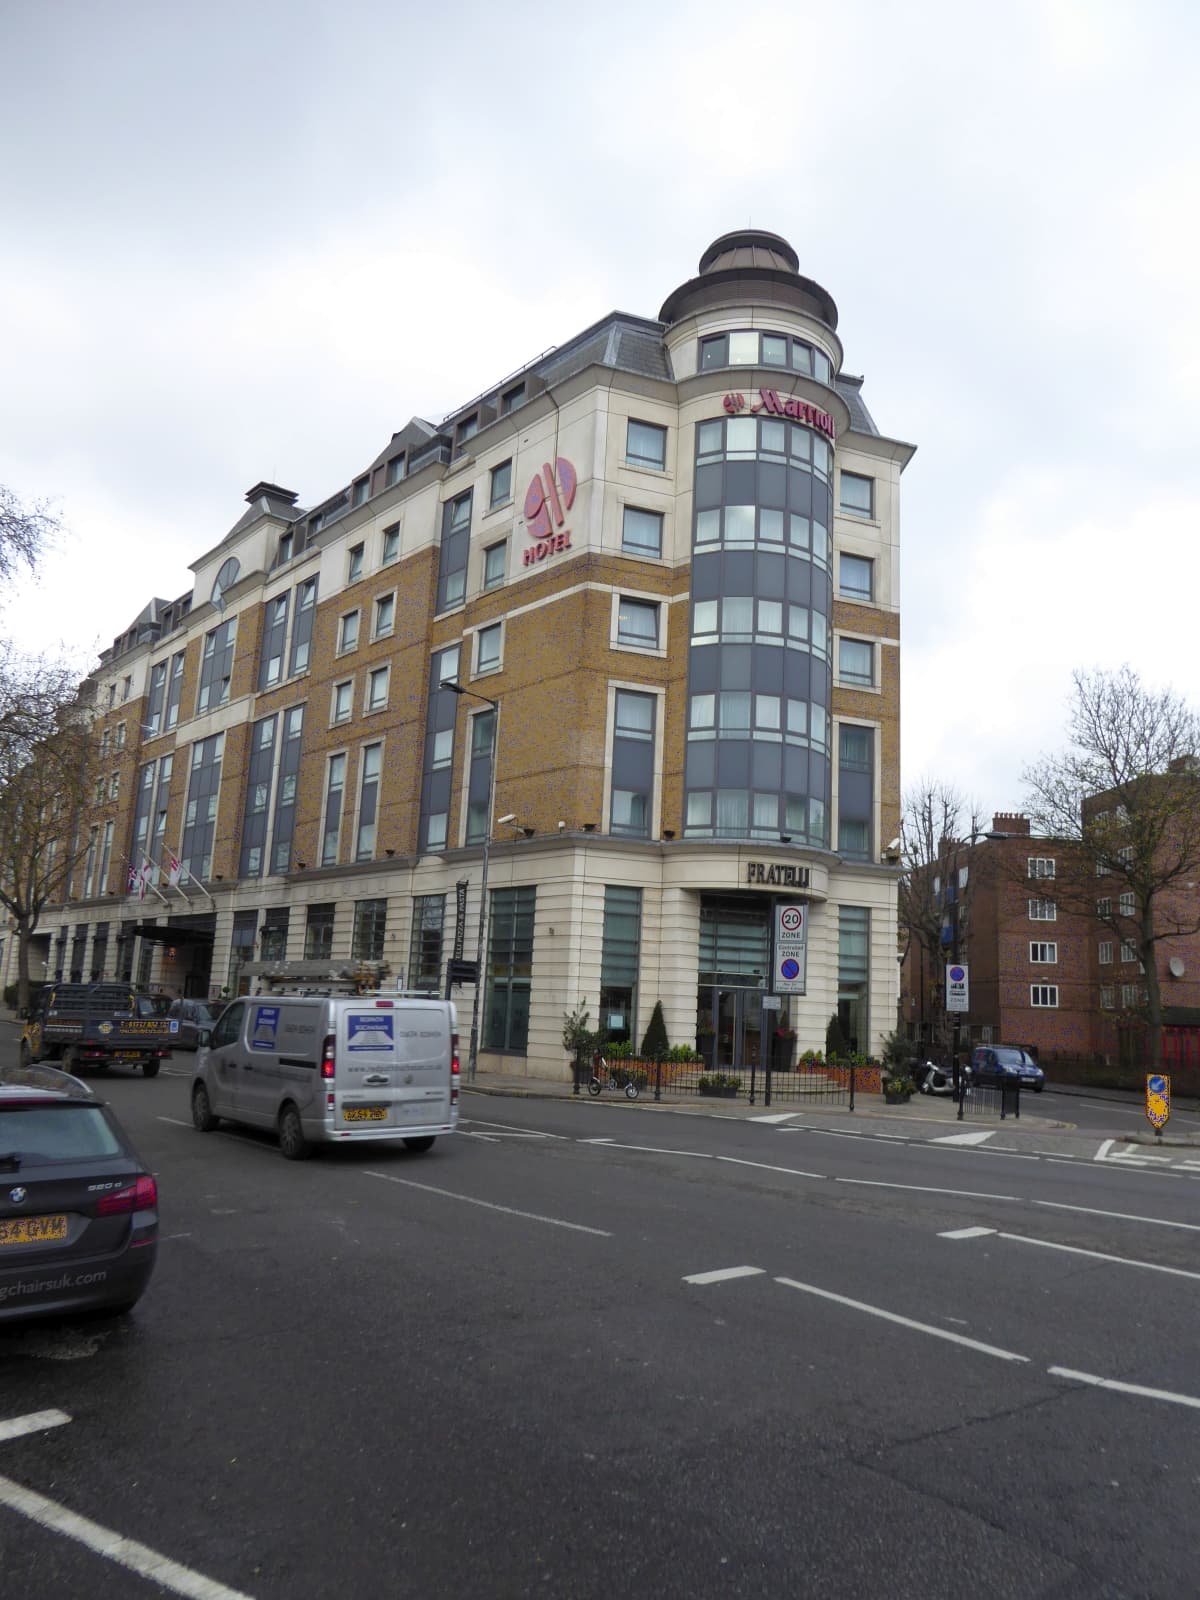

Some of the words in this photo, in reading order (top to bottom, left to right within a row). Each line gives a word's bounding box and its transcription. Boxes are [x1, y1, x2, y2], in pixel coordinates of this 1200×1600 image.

[523, 530, 572, 567] HOTEL
[748, 863, 810, 888] FRATELLI
[784, 914, 799, 924] 20
[781, 931, 801, 939] ZONE
